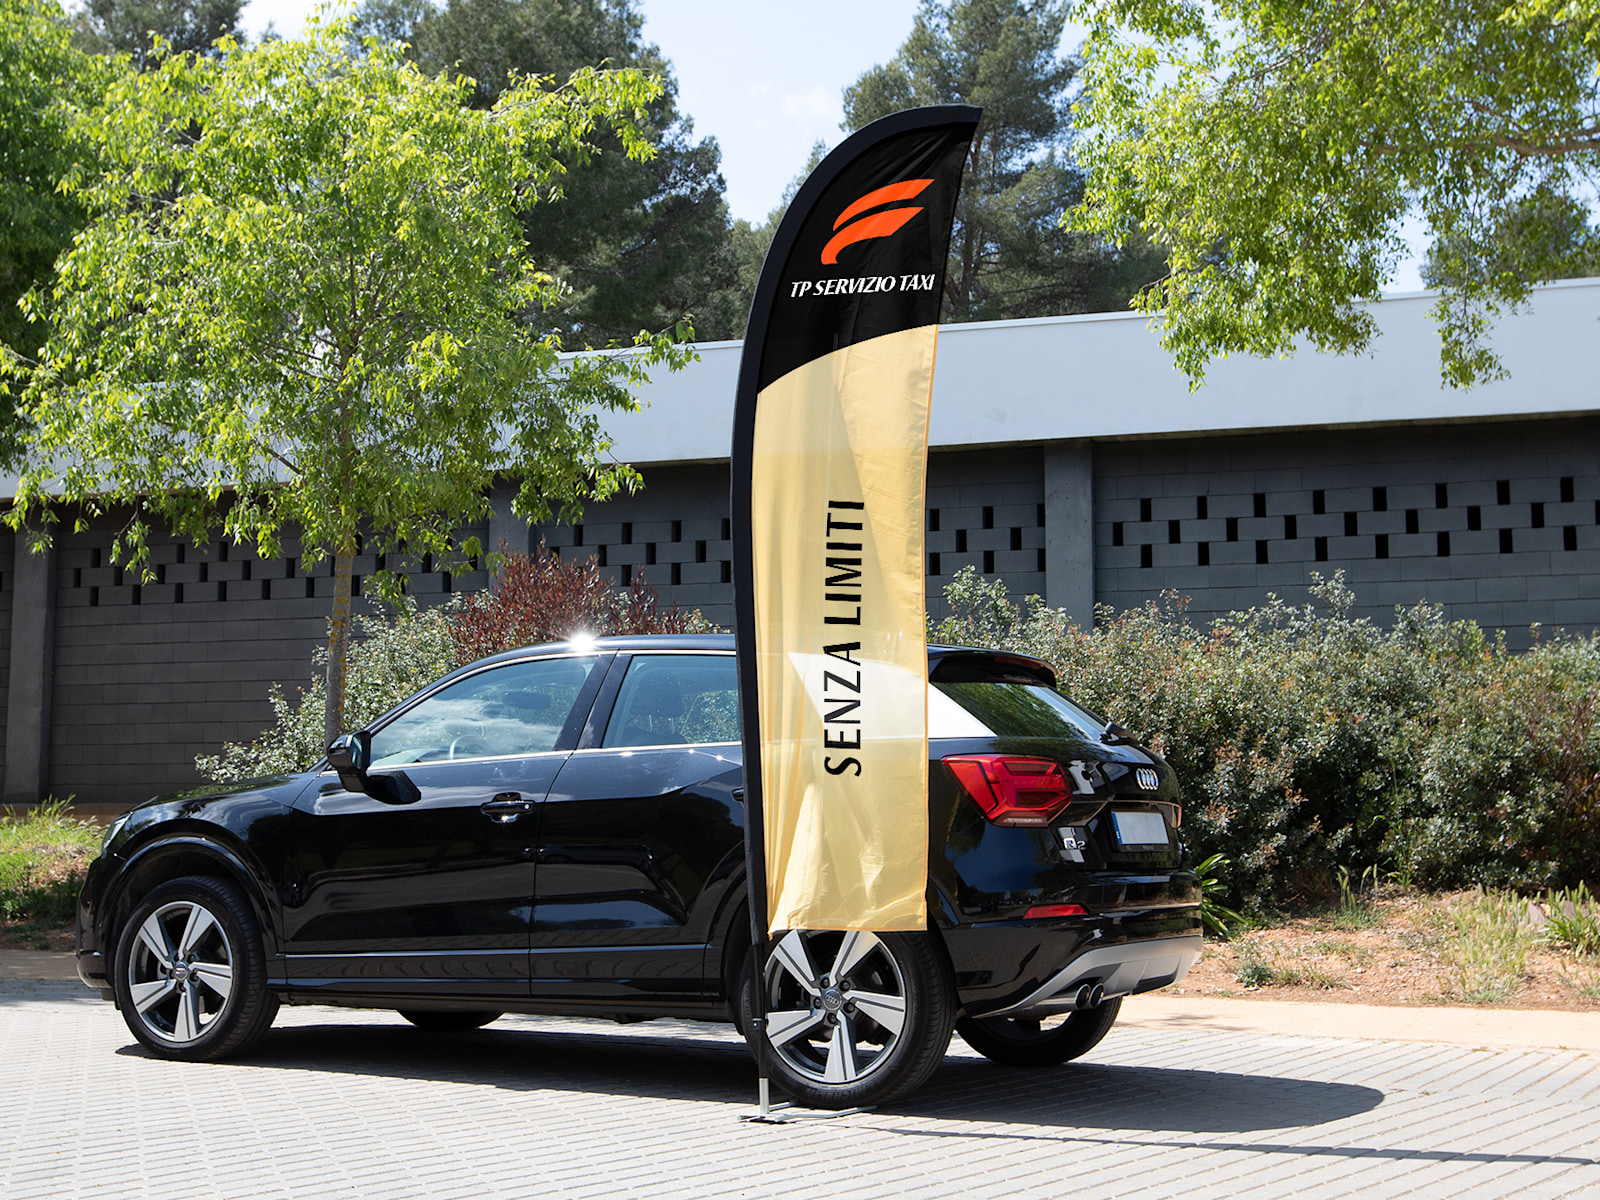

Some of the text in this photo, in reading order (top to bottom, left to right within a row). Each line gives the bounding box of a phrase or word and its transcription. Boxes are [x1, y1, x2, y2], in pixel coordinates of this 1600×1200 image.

[790, 273, 936, 298] TP SERVIZIO TAXI
[823, 500, 864, 777] SENZA LIMITI
